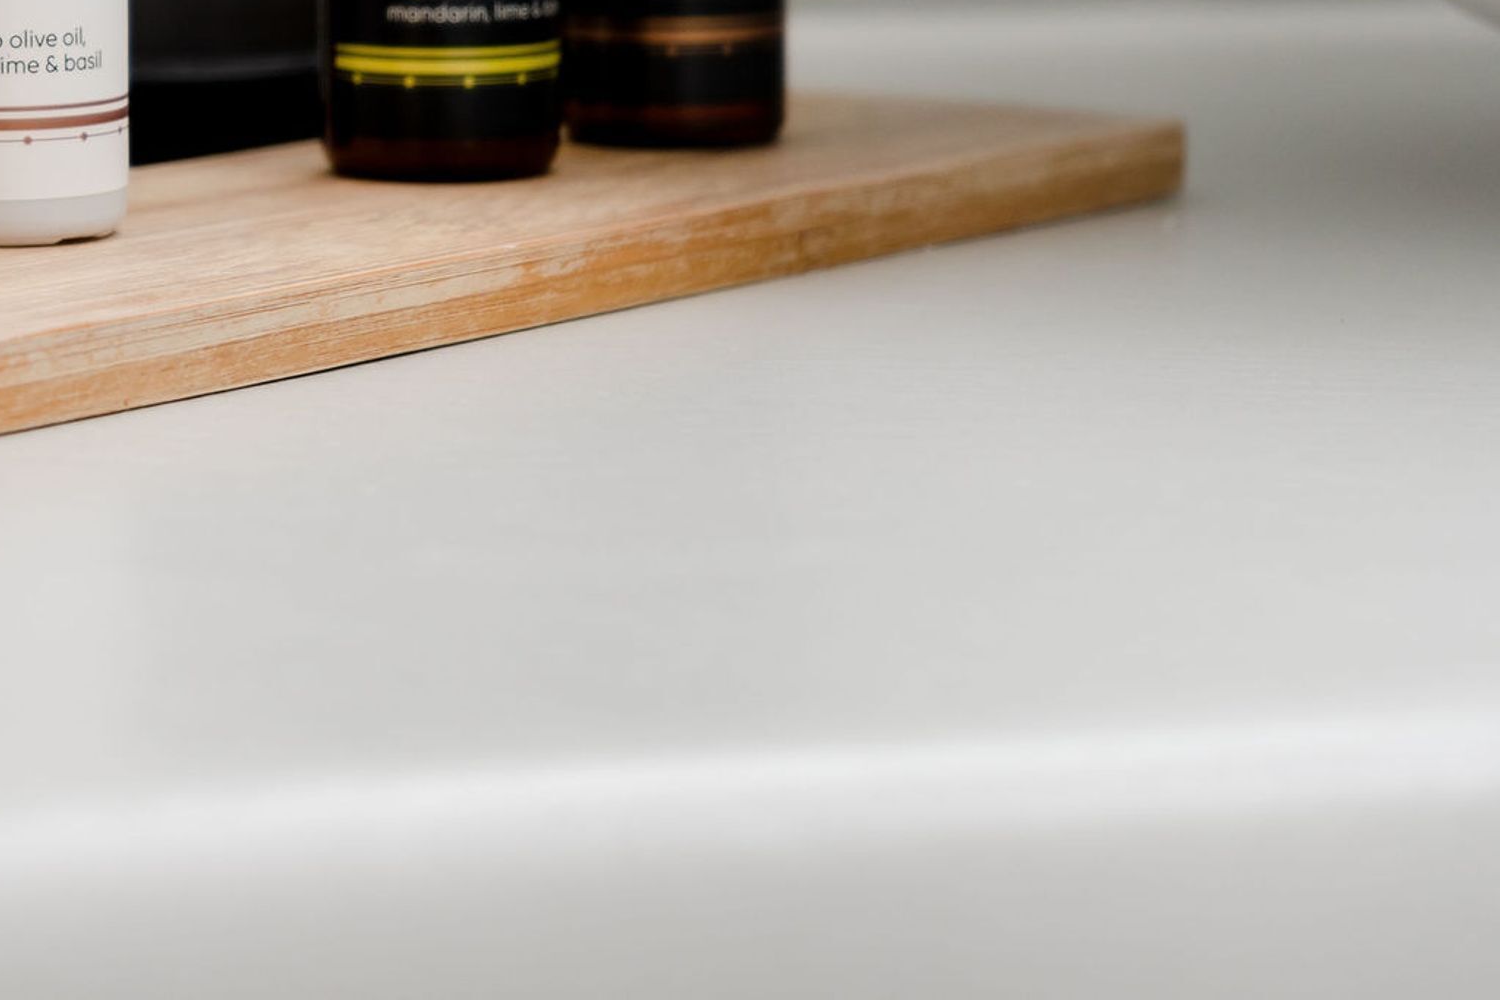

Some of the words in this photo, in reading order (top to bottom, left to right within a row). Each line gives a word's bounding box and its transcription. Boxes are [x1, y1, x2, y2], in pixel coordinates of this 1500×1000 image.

[386, 2, 490, 24] mandarin,
[9, 30, 58, 50] olive
[62, 27, 86, 48] oil,
[45, 55, 59, 73] &
[64, 49, 102, 72] basil
